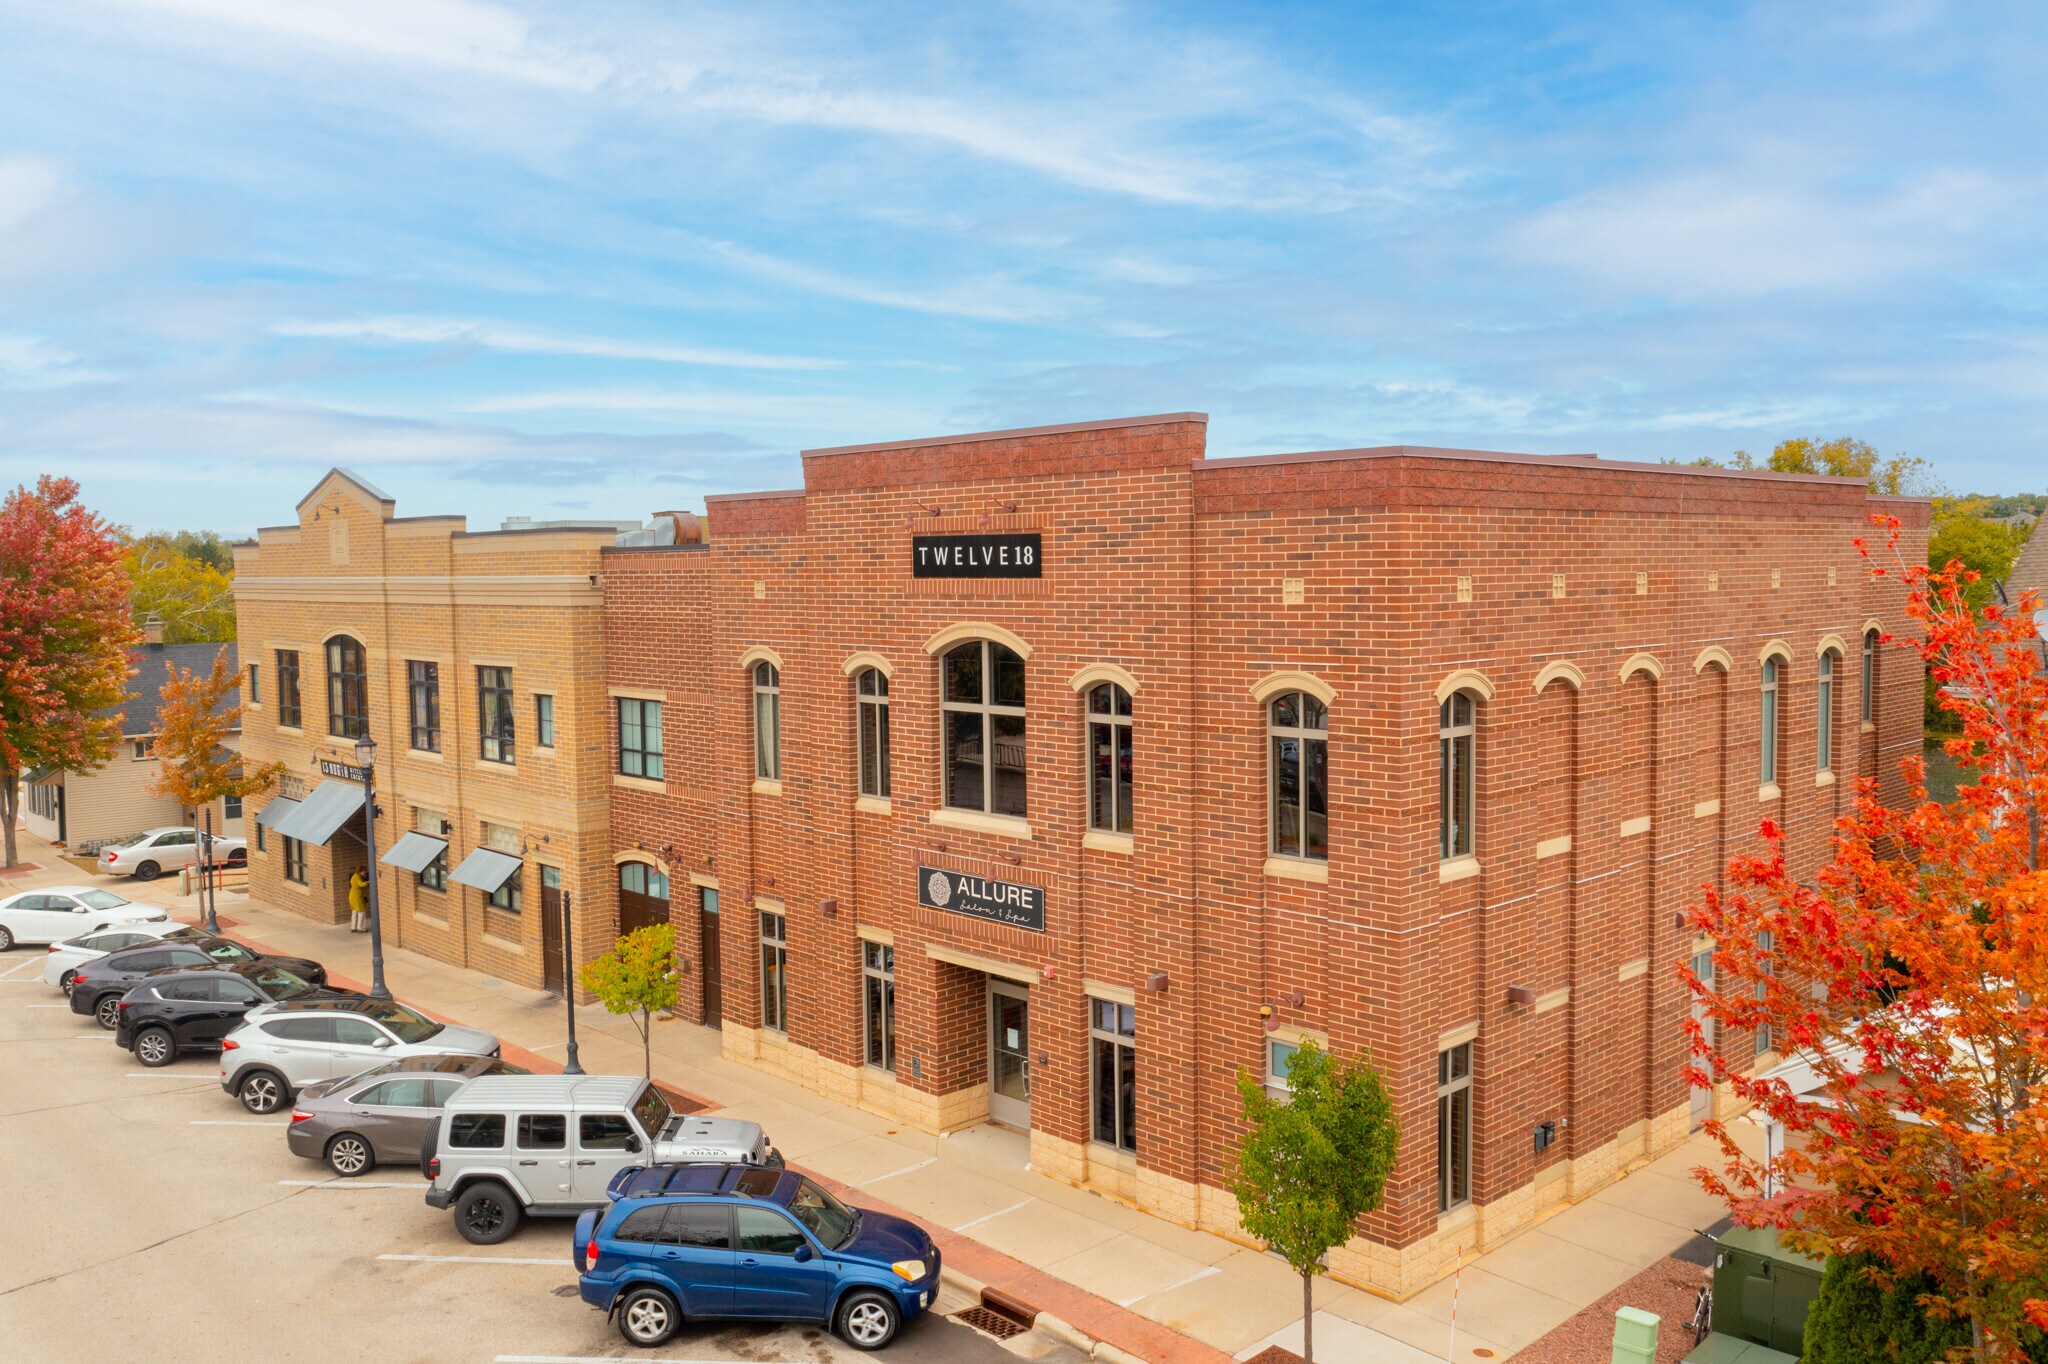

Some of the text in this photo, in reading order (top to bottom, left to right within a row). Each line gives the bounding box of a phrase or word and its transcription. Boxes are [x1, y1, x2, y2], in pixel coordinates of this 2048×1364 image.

[918, 545, 1034, 566] TWELVE18
[957, 876, 1033, 909] ALLURE
[960, 899, 996, 915] Salon
[1005, 908, 1031, 923] Spa
